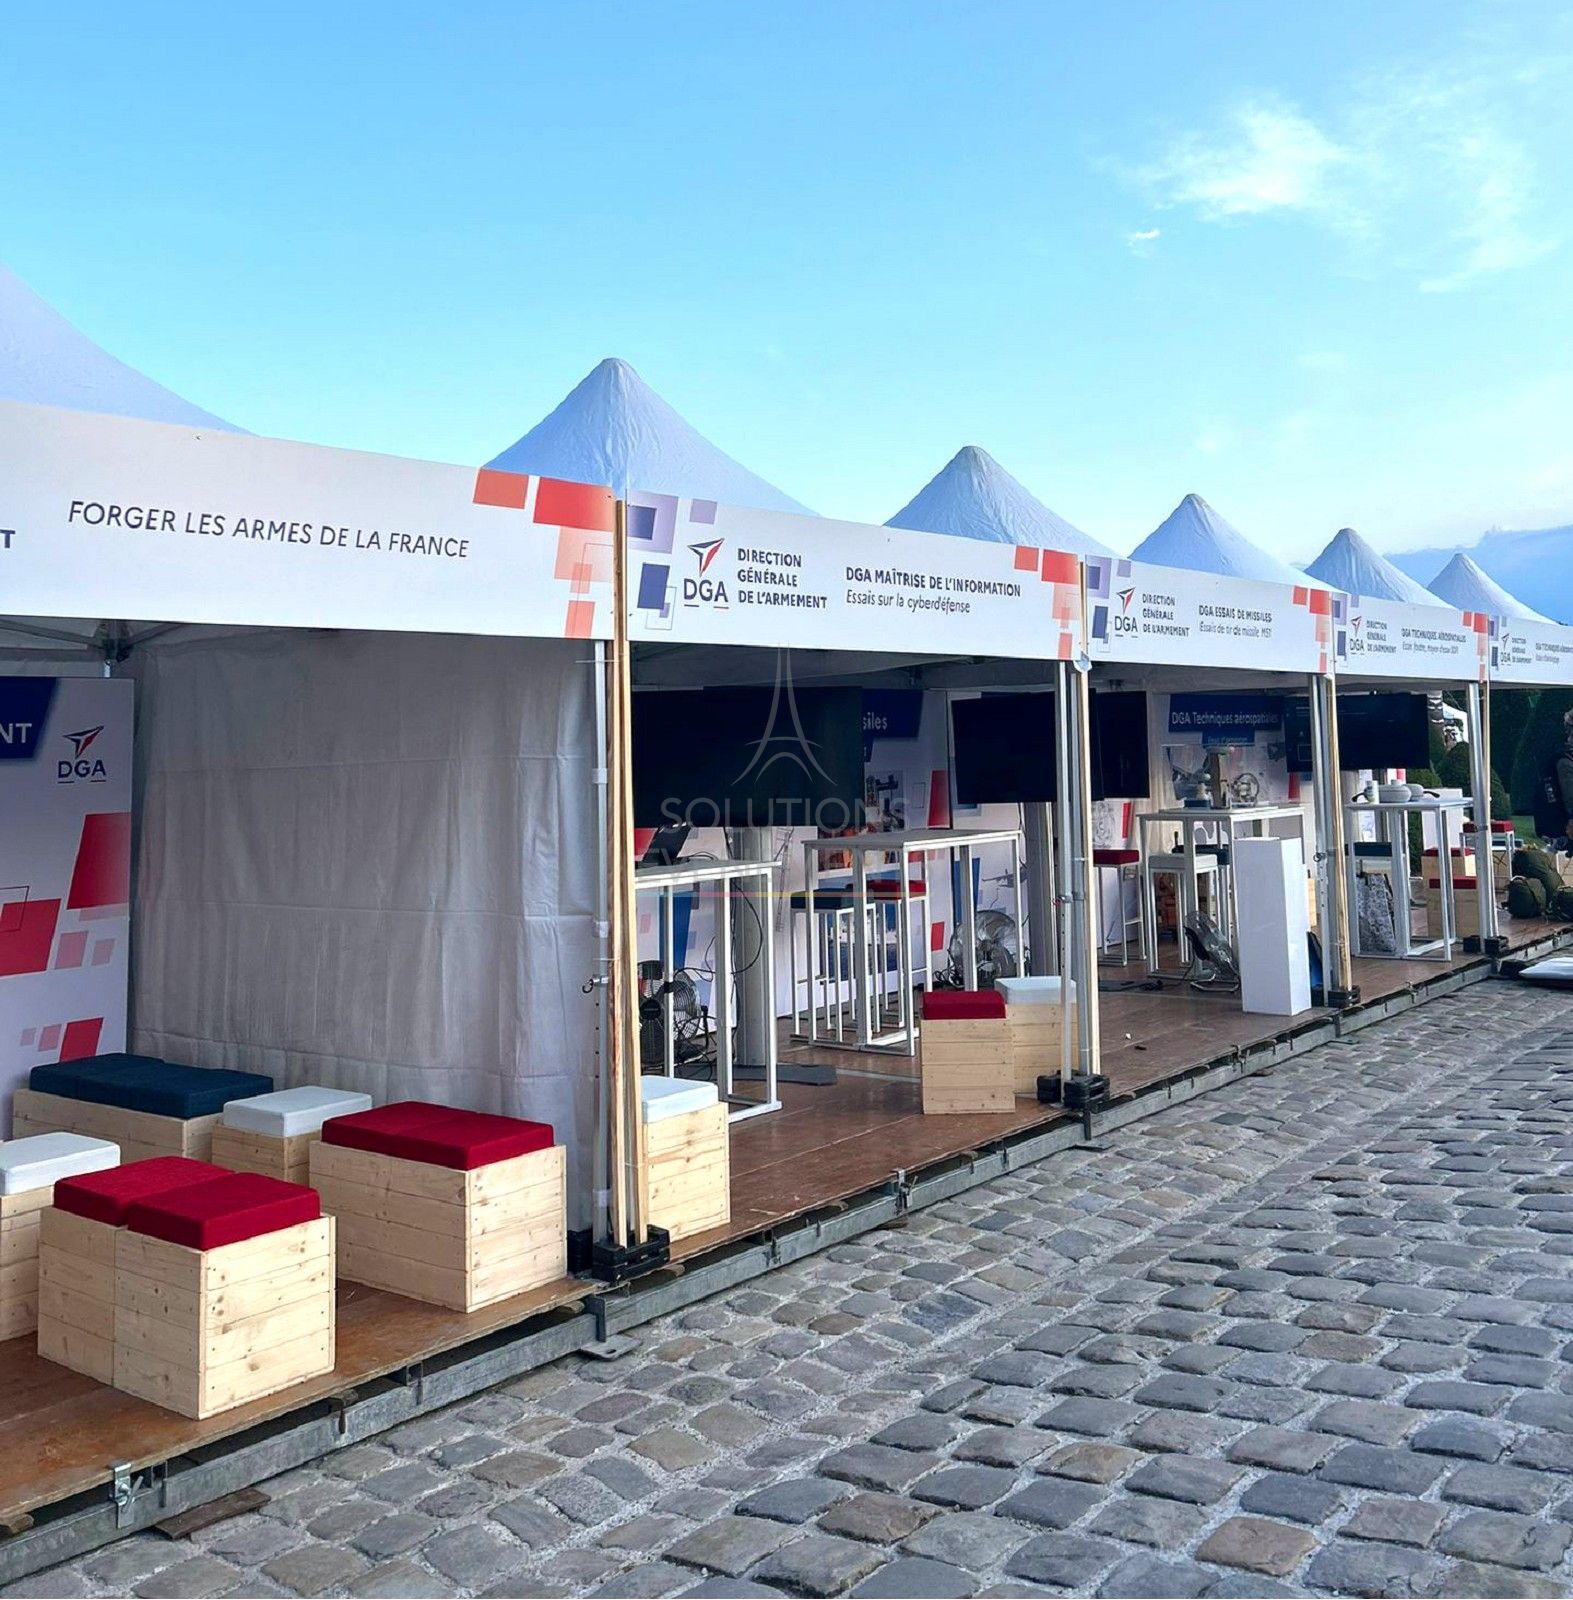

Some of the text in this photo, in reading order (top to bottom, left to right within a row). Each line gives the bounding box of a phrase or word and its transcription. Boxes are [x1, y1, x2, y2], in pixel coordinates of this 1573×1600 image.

[69, 500, 470, 558] FORGER LES ARMES DE LA FRANCE
[737, 548, 802, 568] DIRECTION
[737, 567, 798, 588] GÉNÉRALE
[846, 566, 1021, 597] DGA MAÎTRISE DE L'INFORMATION
[683, 578, 729, 603] DGA
[738, 590, 828, 609] DE L'ARMEMENT
[1142, 593, 1175, 606] DIRECTION
[846, 589, 971, 615] Essais sur la cyberdéfense
[1199, 604, 1272, 623] DGA ESSAIS DE MISSILES
[1114, 615, 1138, 633] DGA
[1143, 623, 1151, 633] DE
[1349, 638, 1365, 652] DGA
[1171, 711, 1192, 725] DGA
[1193, 711, 1233, 727] Techniques
[57, 759, 107, 779] DGA
